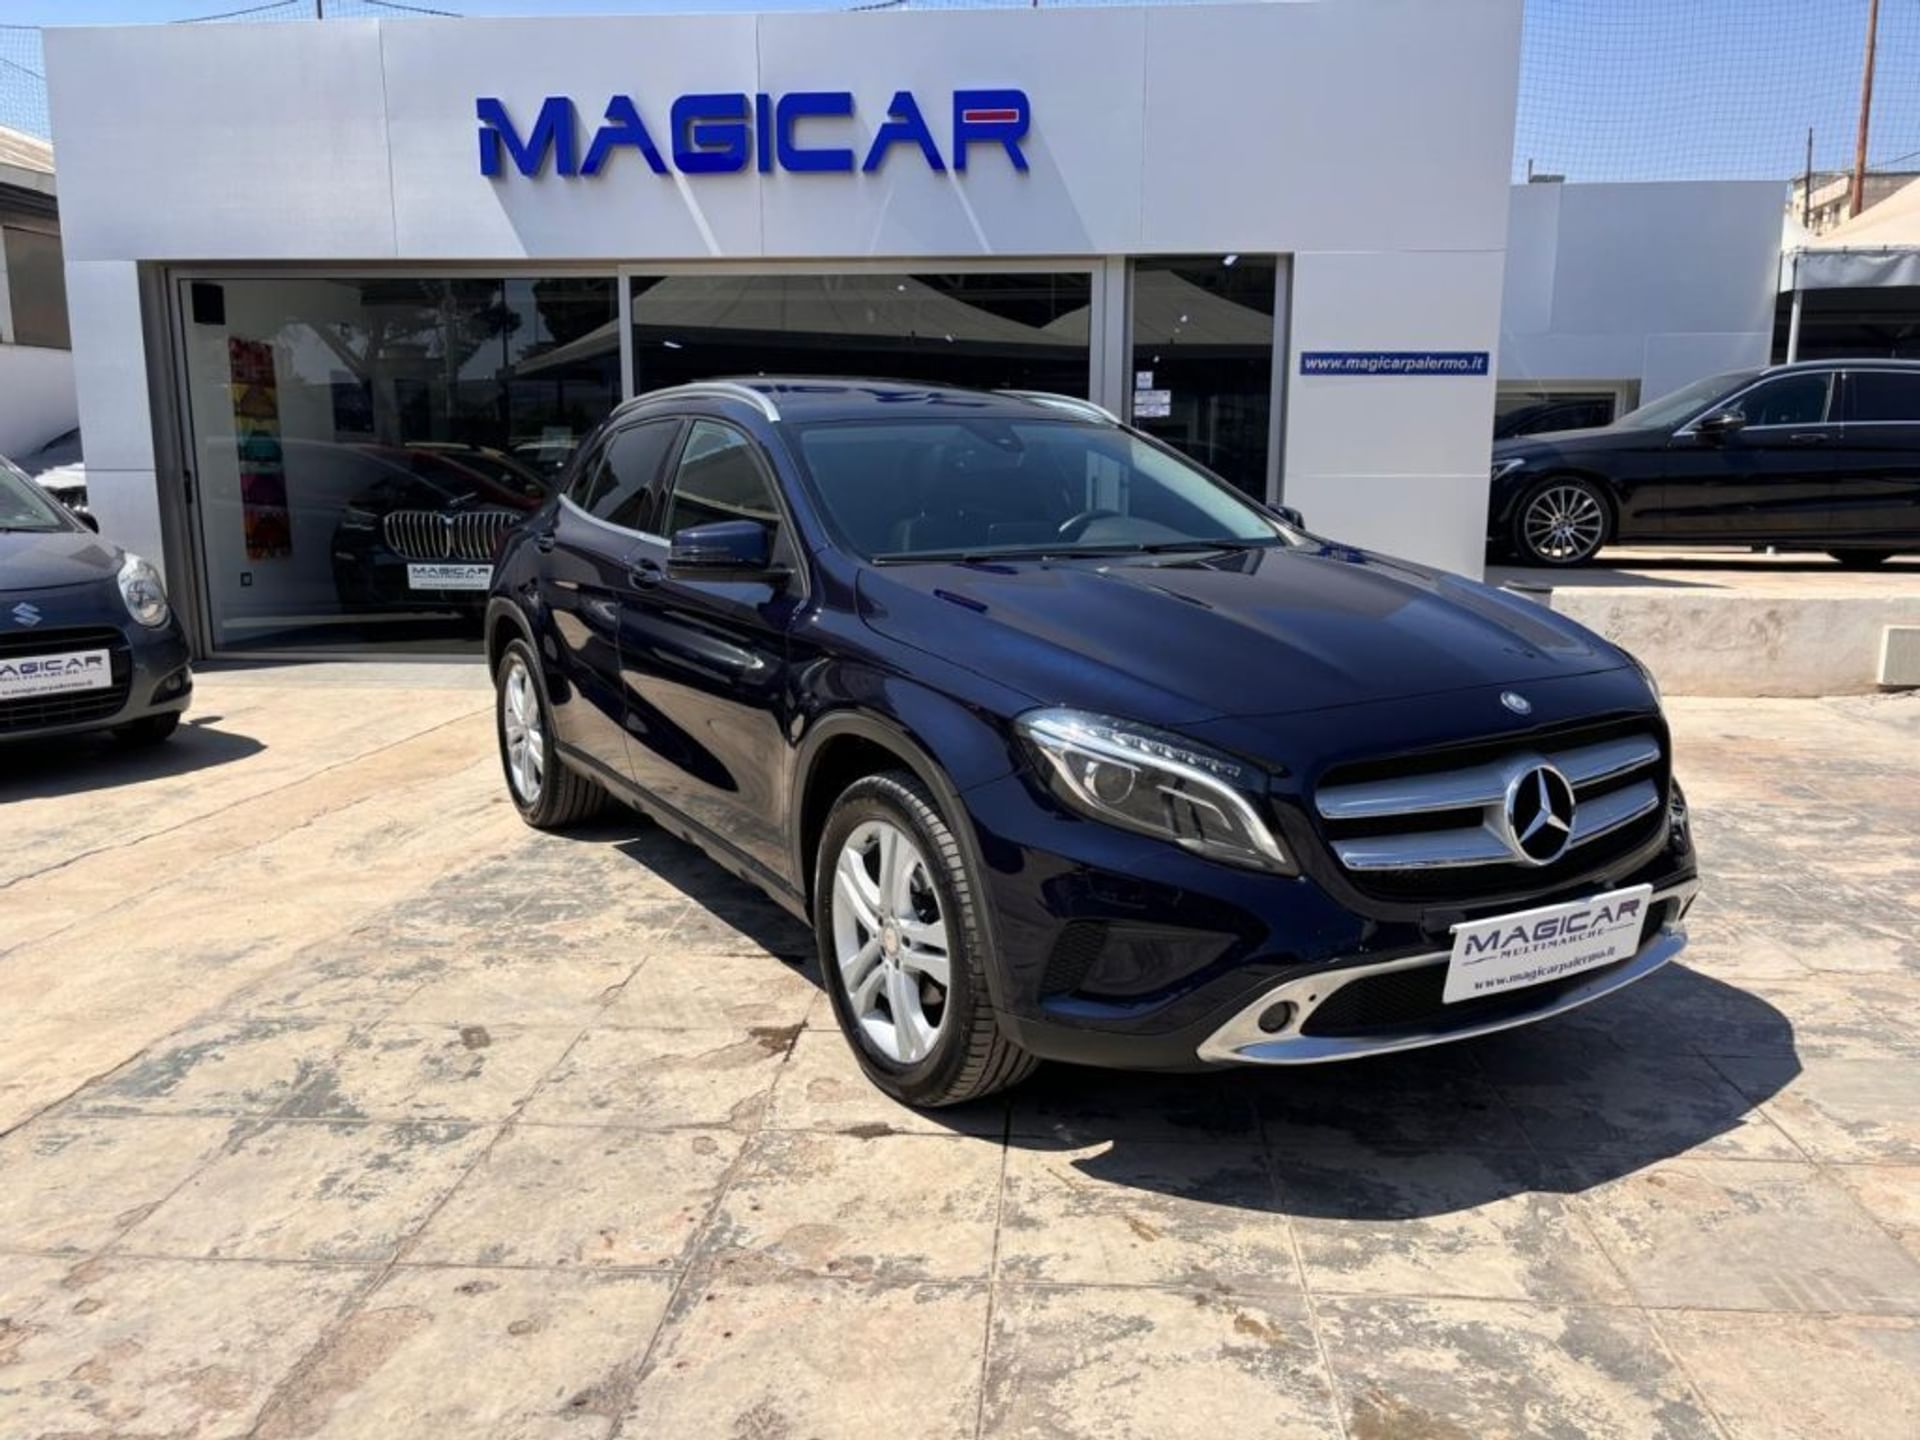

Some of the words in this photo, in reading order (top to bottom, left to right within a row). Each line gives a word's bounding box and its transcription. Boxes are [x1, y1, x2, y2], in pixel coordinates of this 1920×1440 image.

[476, 89, 1031, 177] MAGICAR
[1304, 354, 1484, 373] www.magicarpalermo.it
[0, 655, 103, 676] AGICAR
[1464, 898, 1642, 956] MAGICAR
[1499, 927, 1606, 959] MULTIMARCHE
[1473, 945, 1617, 990] www.magicarpalermo.it
